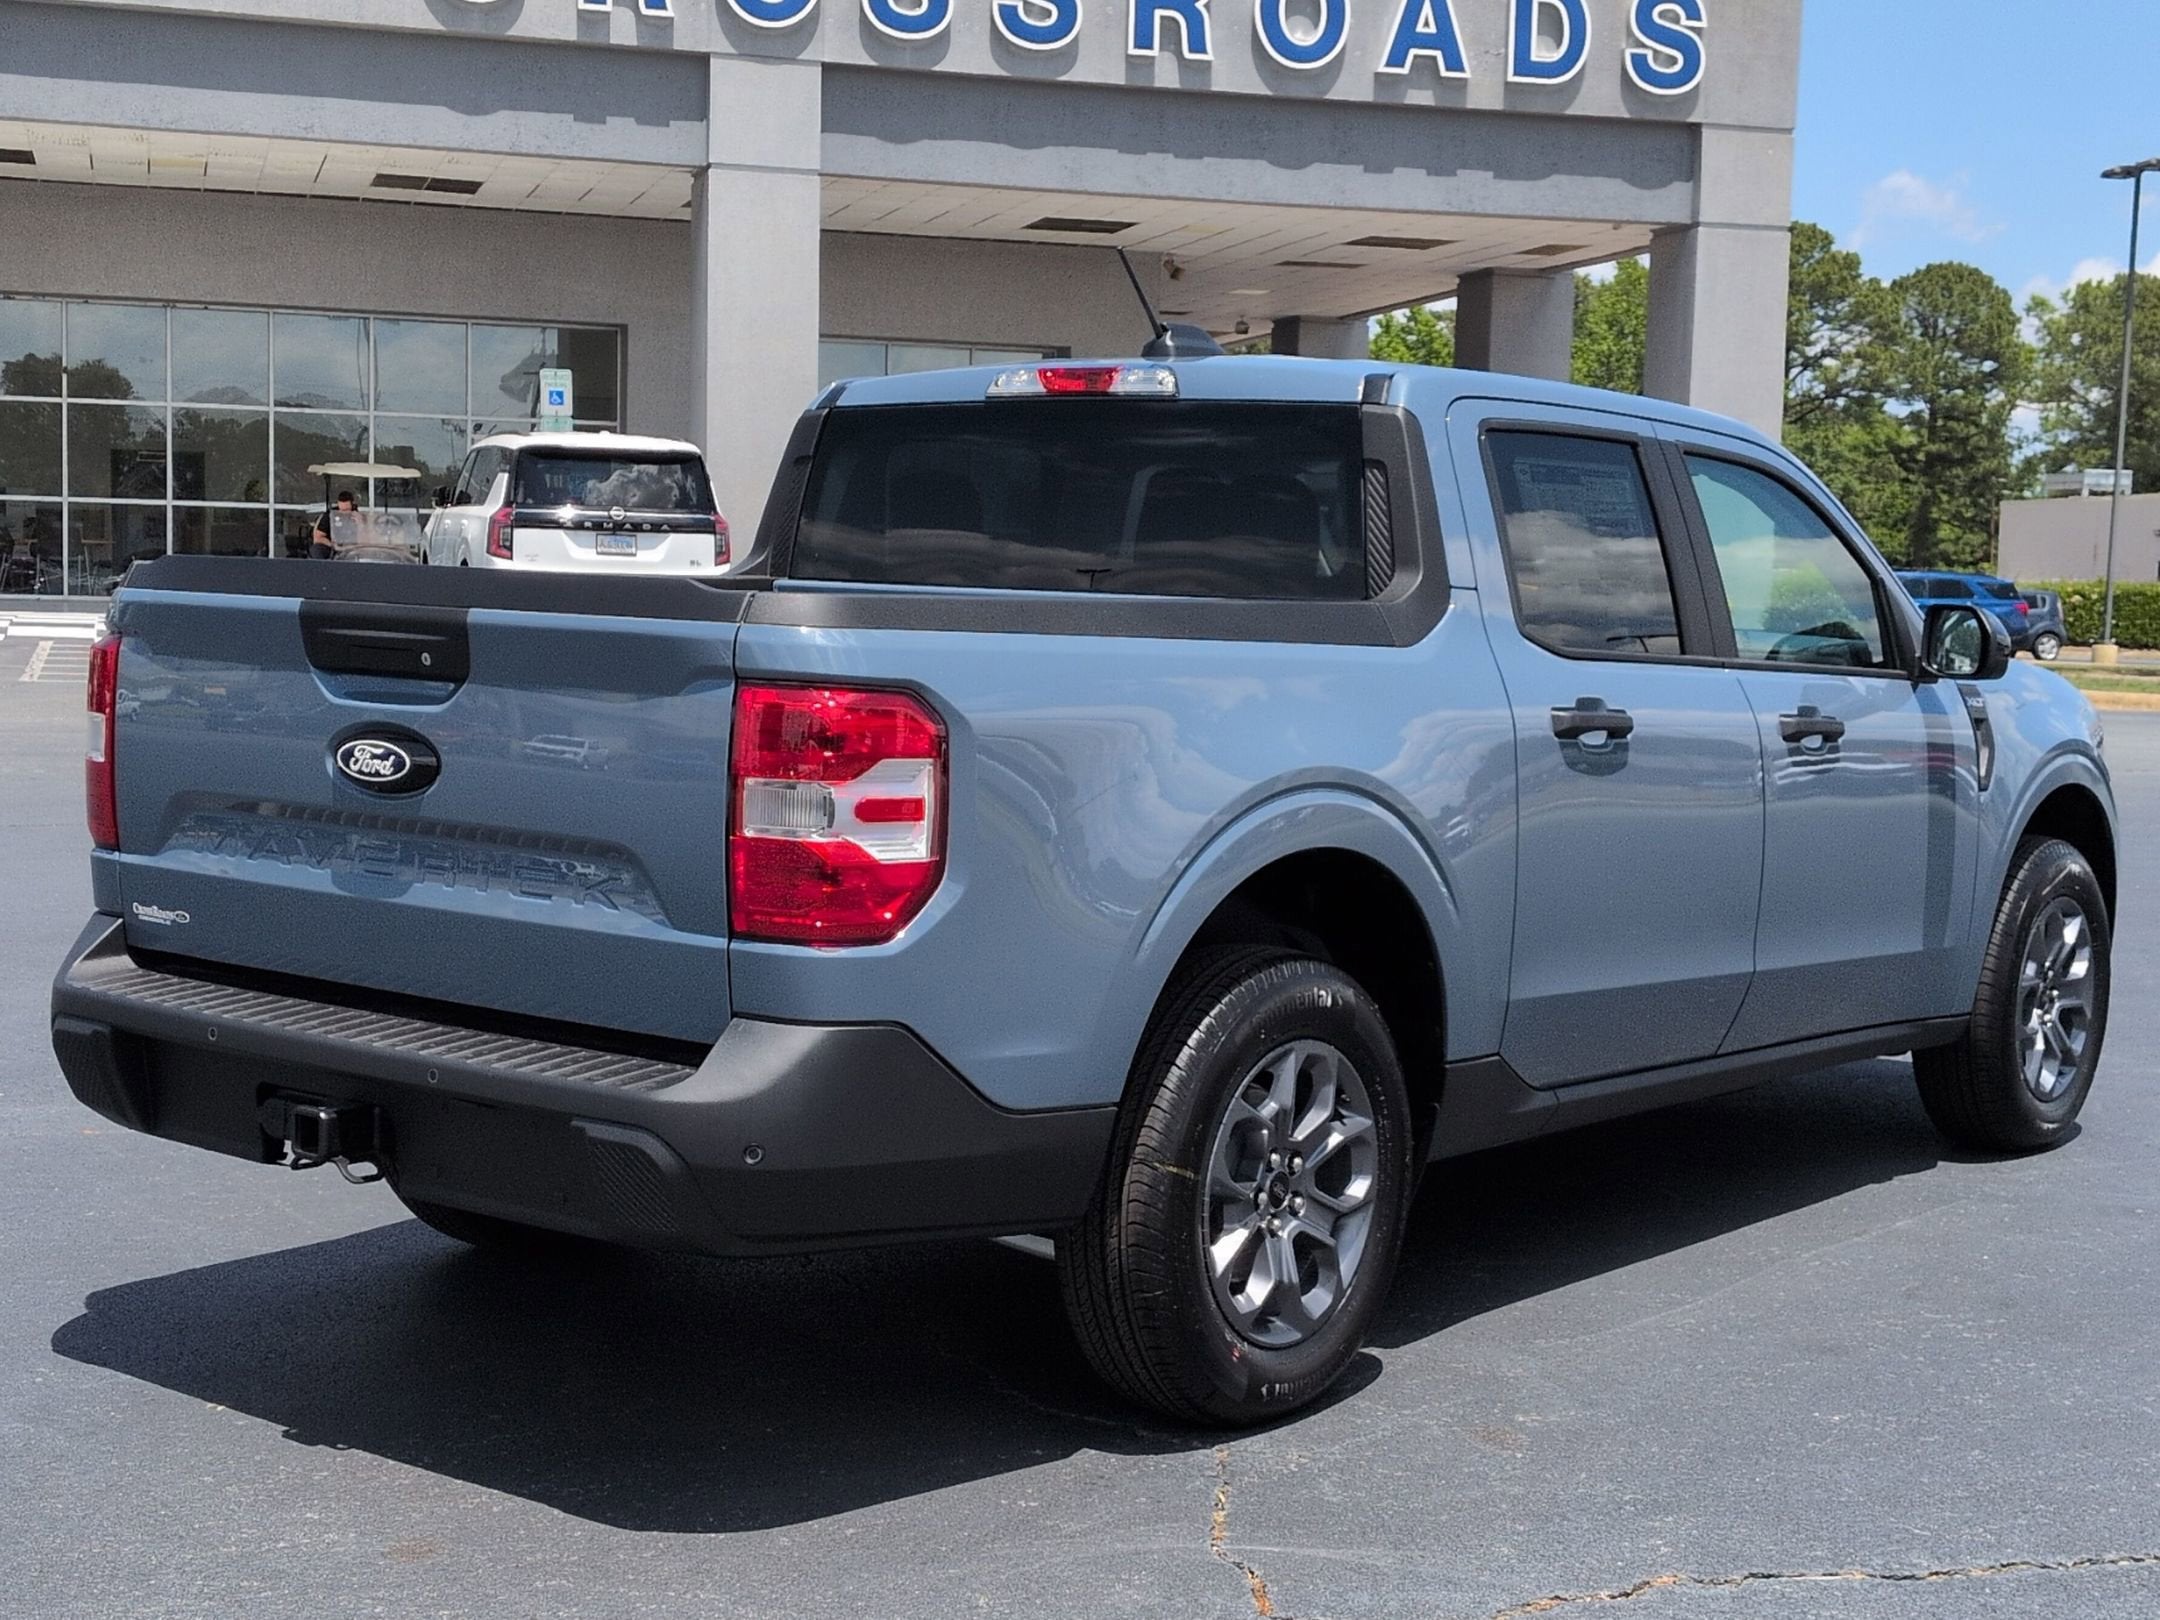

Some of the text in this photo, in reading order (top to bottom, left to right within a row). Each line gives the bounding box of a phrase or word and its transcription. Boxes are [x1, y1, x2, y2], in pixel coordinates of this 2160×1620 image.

[463, 0, 1707, 94] SROADS
[562, 521, 671, 531] ARMADA
[349, 744, 396, 775] Ford
